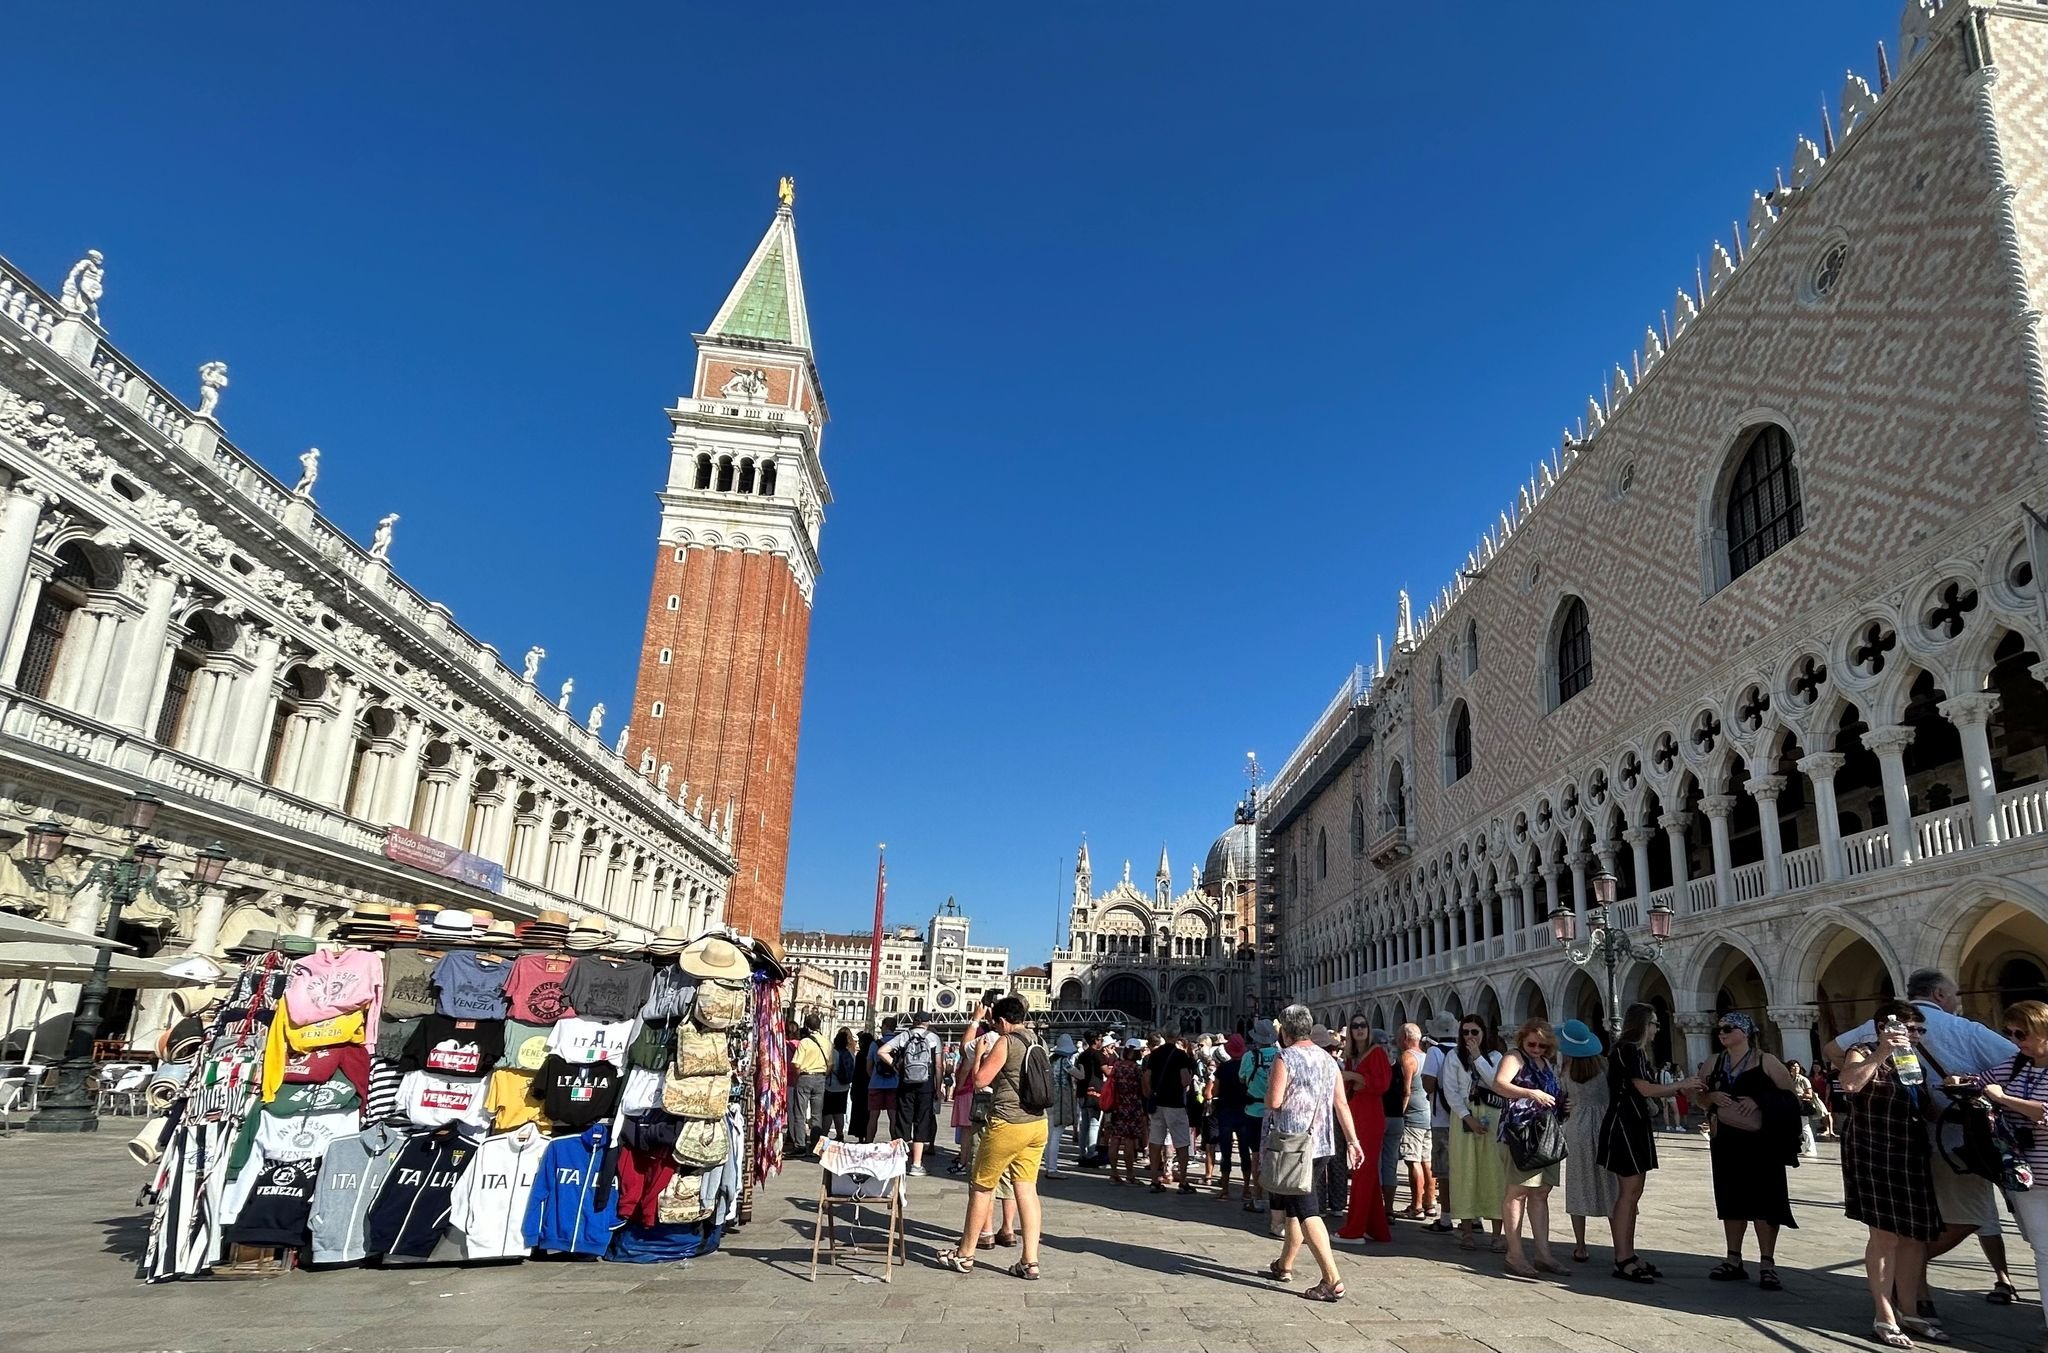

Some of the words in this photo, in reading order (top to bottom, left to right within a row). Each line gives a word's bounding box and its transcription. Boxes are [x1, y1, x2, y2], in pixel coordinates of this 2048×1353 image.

[532, 982, 561, 996] VENE
[391, 991, 435, 1006] VENEZIA
[453, 997, 495, 1012] VENEZIA
[574, 1037, 623, 1050] ITALIA
[429, 1052, 478, 1066] VENEZIA
[557, 1075, 609, 1089] ITALIA
[423, 1091, 471, 1106] VENEZIA
[277, 1120, 334, 1140] UNIVRSITA
[256, 1185, 303, 1198] VENEZIA
